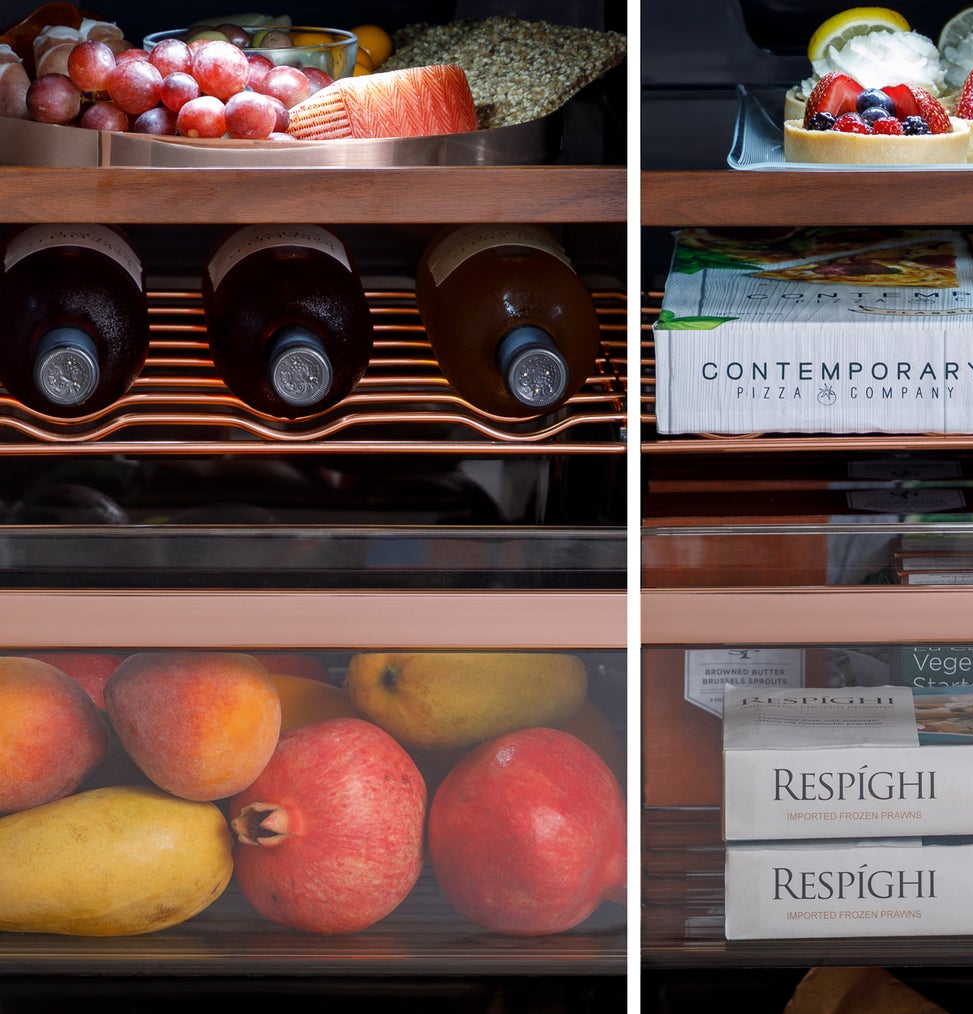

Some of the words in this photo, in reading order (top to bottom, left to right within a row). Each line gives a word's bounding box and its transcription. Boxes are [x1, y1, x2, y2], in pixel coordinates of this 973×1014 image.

[737, 387, 801, 399] PIZZA
[850, 386, 955, 399] COMPANY
[704, 668, 749, 676] BROWNED
[751, 668, 785, 676] BUTTER
[787, 812, 837, 821] IMPORTED
[839, 812, 878, 820] FROZEN
[881, 811, 922, 819] PRAWNS
[786, 911, 837, 920] IMPORTED
[839, 911, 878, 919] FROZEN
[880, 910, 922, 919] PRAWNS
